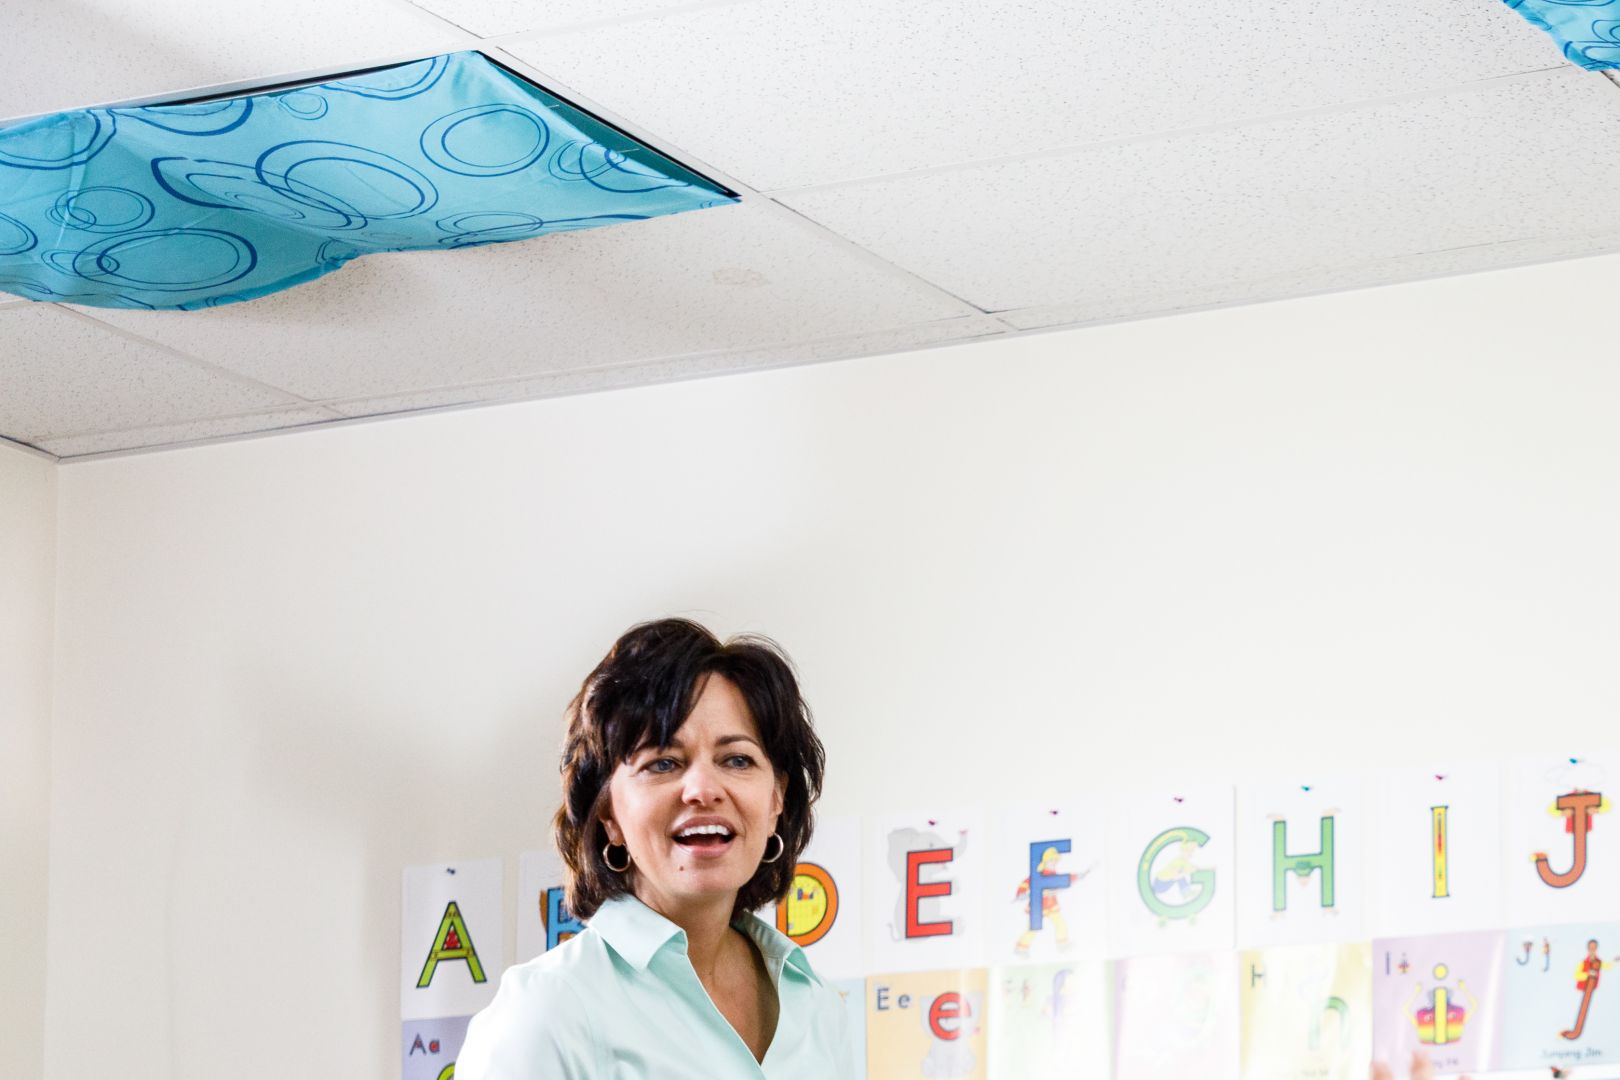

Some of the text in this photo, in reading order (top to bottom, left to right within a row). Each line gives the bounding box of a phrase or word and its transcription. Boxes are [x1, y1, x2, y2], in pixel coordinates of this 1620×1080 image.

[1030, 838, 1072, 931] F
[1137, 826, 1217, 920] G
[1273, 816, 1334, 911] H
[1431, 805, 1449, 899] I
[1536, 792, 1602, 889] J
[776, 862, 839, 948] D
[905, 847, 954, 940] E
[416, 900, 488, 989] A
[928, 991, 972, 1042] e
